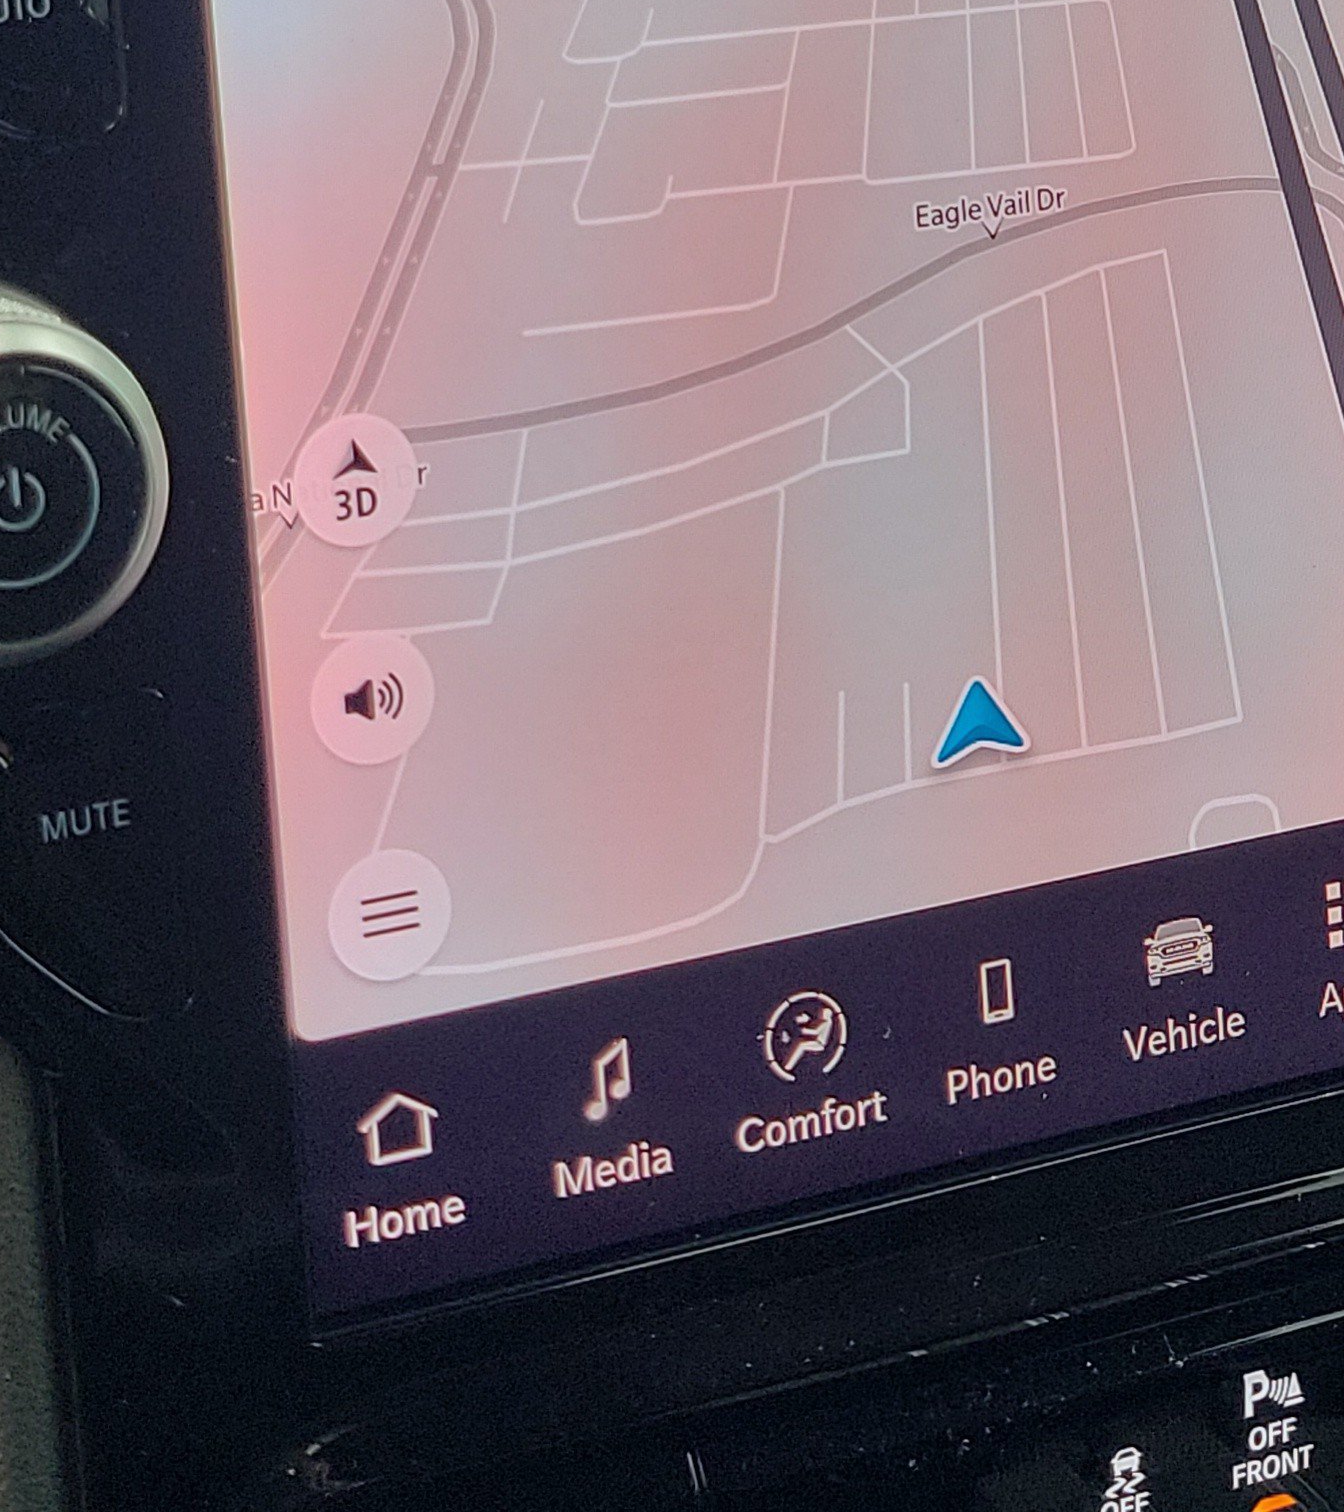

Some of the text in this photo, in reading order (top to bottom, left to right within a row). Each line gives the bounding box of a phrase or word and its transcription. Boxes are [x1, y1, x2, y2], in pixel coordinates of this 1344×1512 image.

[915, 188, 1066, 230] Eagle Vail Dr
[335, 488, 378, 521] 3D
[39, 799, 131, 845] MUTE
[344, 1194, 466, 1249] Home
[556, 1141, 674, 1198] Media
[736, 1091, 888, 1153] Comfort
[946, 1054, 1057, 1105] Phone
[1123, 1008, 1246, 1063] Vehicle
[1248, 1416, 1298, 1451] OFF
[1231, 1443, 1315, 1491] FRONT
